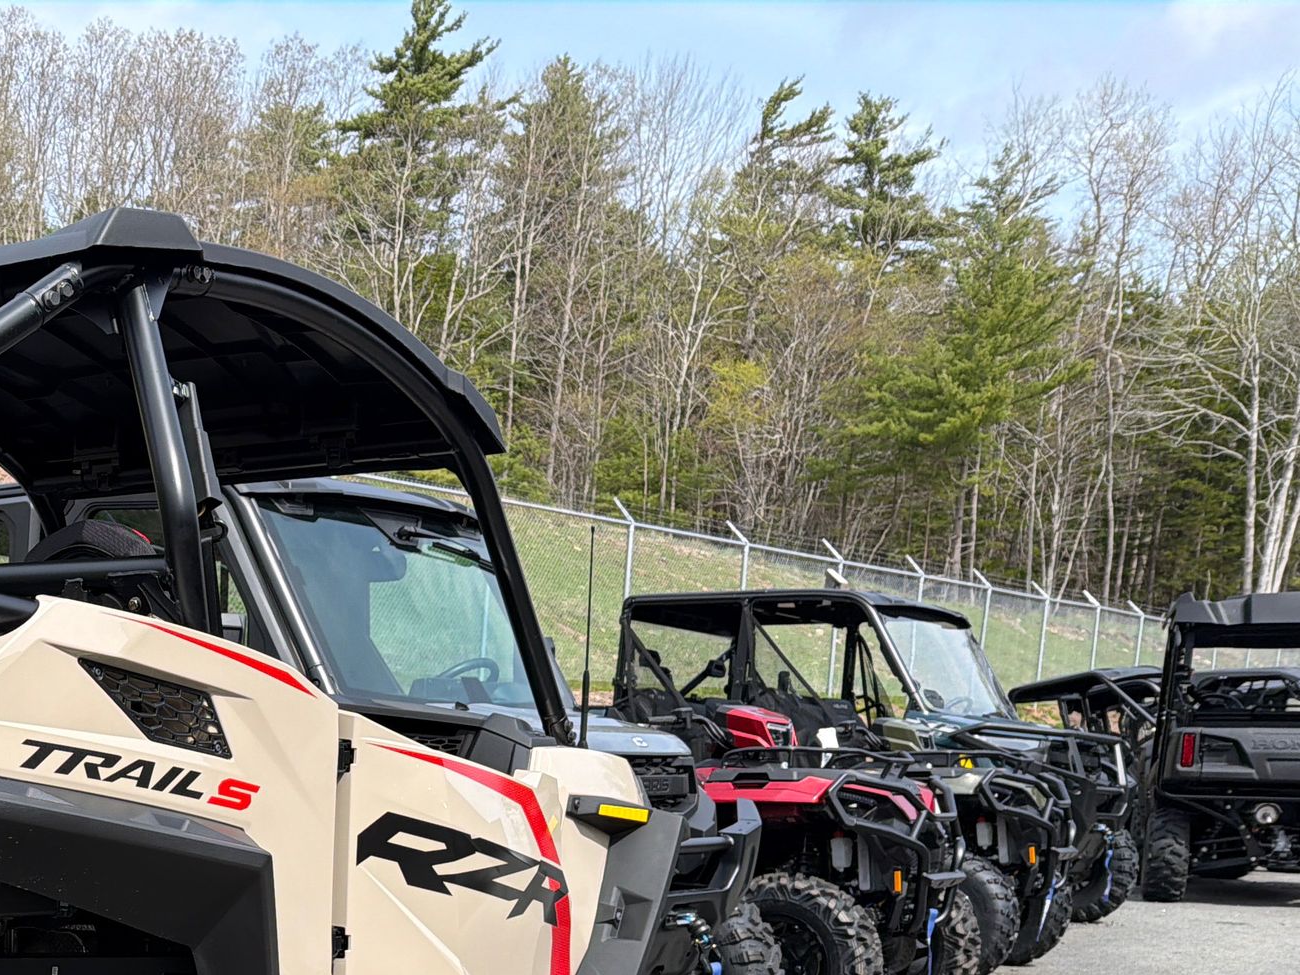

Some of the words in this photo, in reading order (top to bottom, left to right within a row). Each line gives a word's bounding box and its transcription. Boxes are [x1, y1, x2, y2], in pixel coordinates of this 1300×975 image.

[20, 739, 204, 800] TRAIL
[207, 778, 261, 811] S
[356, 811, 569, 928] RZR
